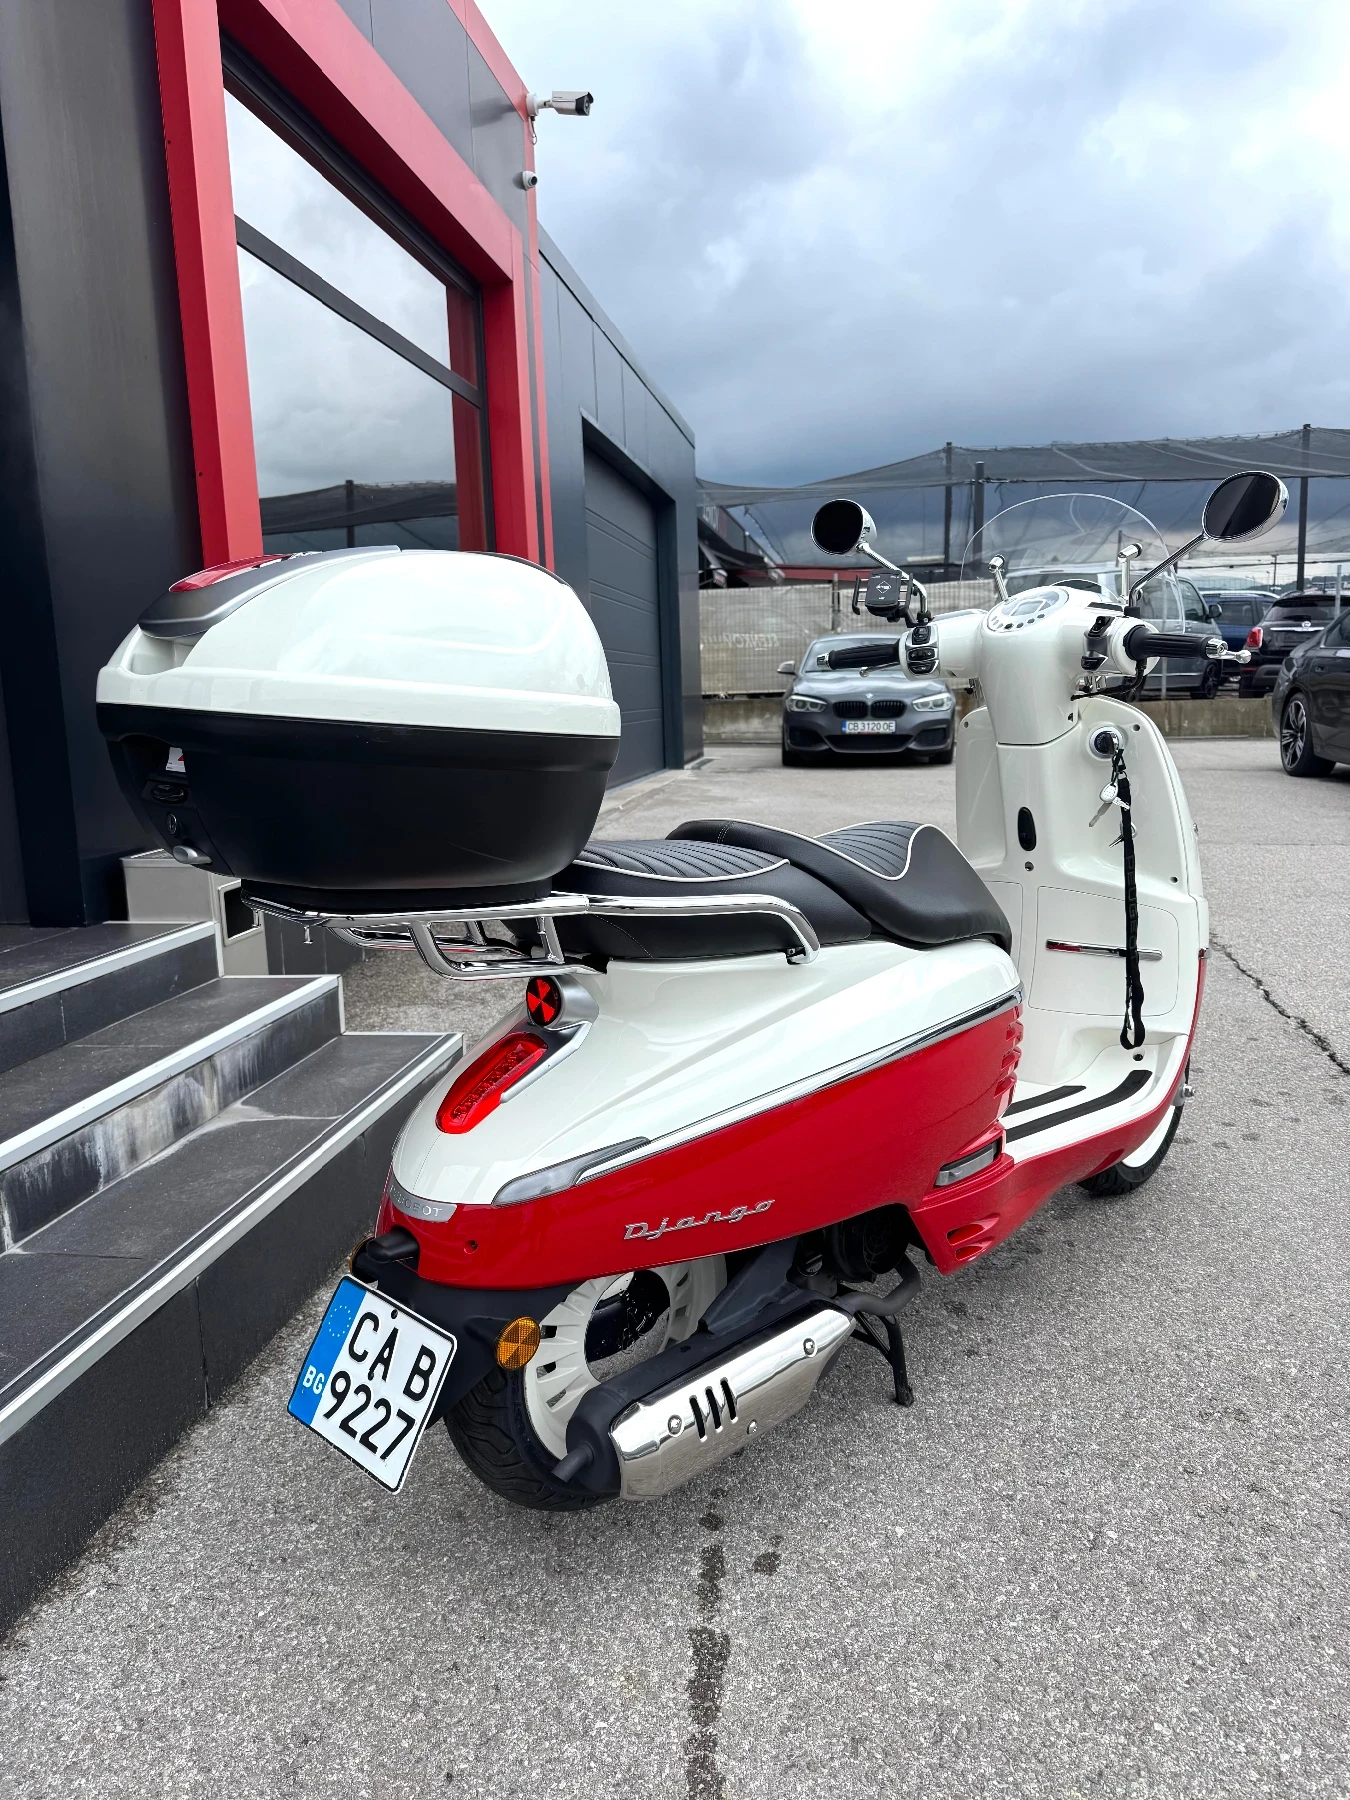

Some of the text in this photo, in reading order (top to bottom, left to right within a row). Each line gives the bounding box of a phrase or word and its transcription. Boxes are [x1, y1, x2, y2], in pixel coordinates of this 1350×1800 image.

[847, 722, 859, 731] CB
[860, 722, 881, 731] 3120
[623, 1199, 776, 1241] Django
[348, 1311, 437, 1402] CA B
[302, 1365, 325, 1395] BG
[322, 1370, 417, 1461] 9227
